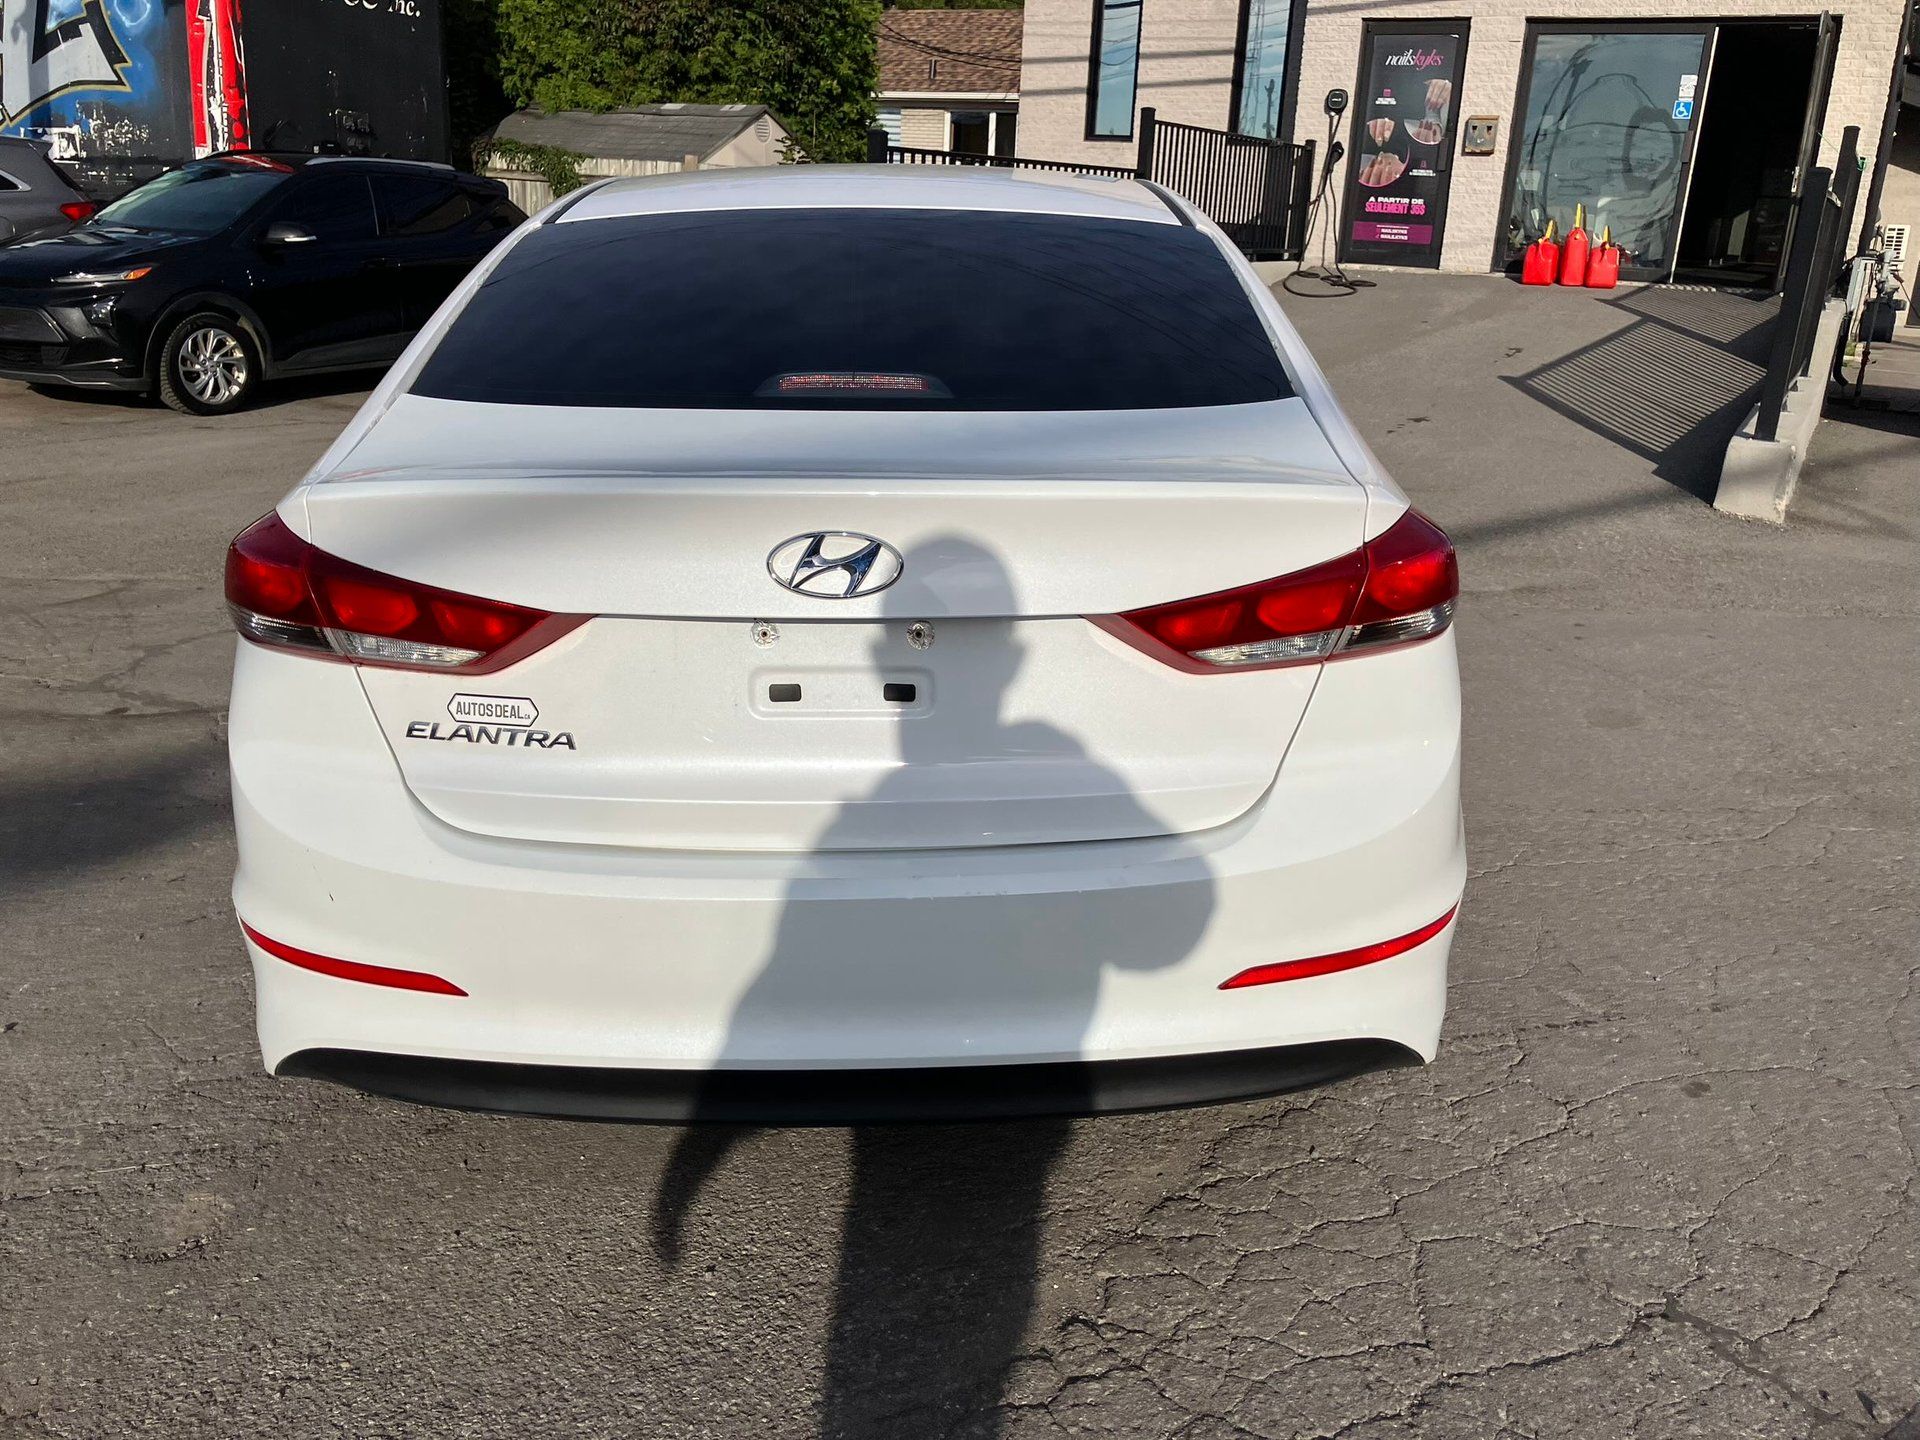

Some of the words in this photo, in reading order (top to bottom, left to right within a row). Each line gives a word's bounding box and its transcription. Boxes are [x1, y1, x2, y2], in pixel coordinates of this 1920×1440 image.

[1377, 196, 1410, 204] PARTIR
[1365, 202, 1409, 214] SEULEMENT
[406, 720, 577, 750] ELANTRA
